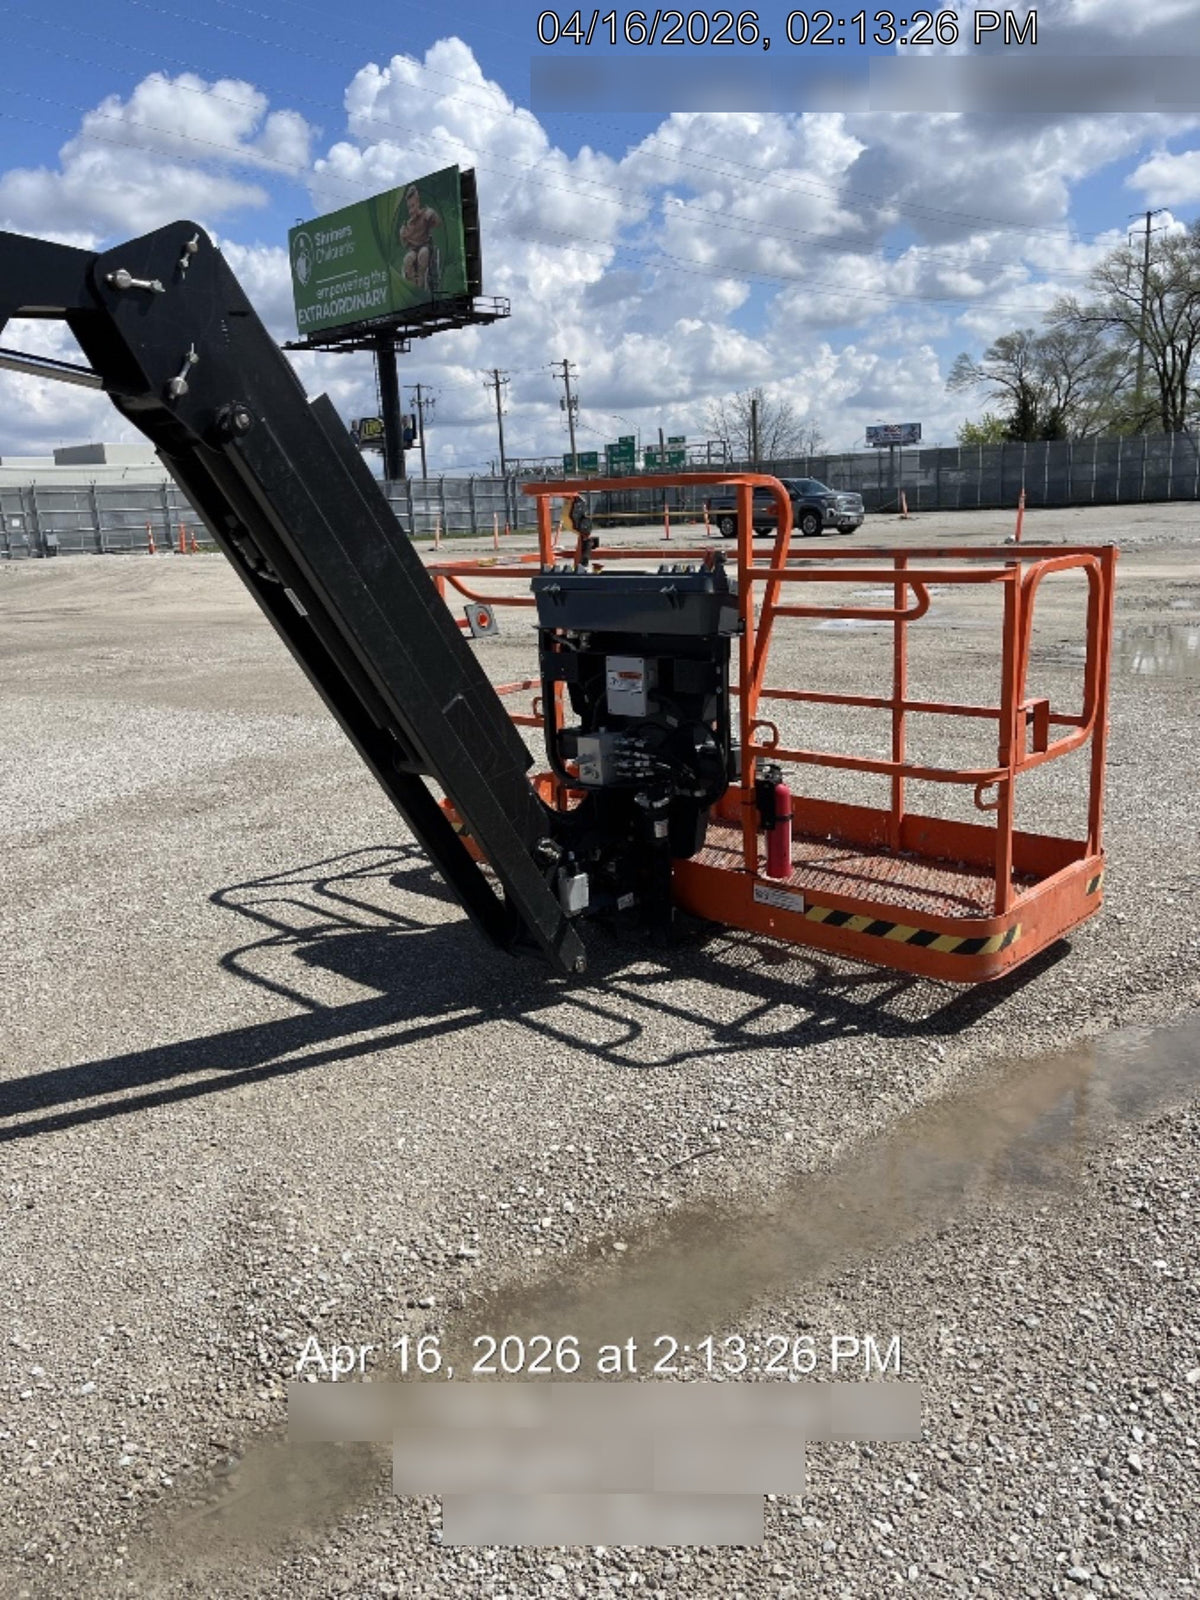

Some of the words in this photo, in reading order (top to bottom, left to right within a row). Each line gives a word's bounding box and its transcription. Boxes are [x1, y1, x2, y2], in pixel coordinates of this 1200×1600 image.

[314, 225, 353, 247] Shriners
[316, 274, 371, 299] empowering
[371, 269, 388, 284] the
[298, 286, 388, 325] EXTRAORDINARY
